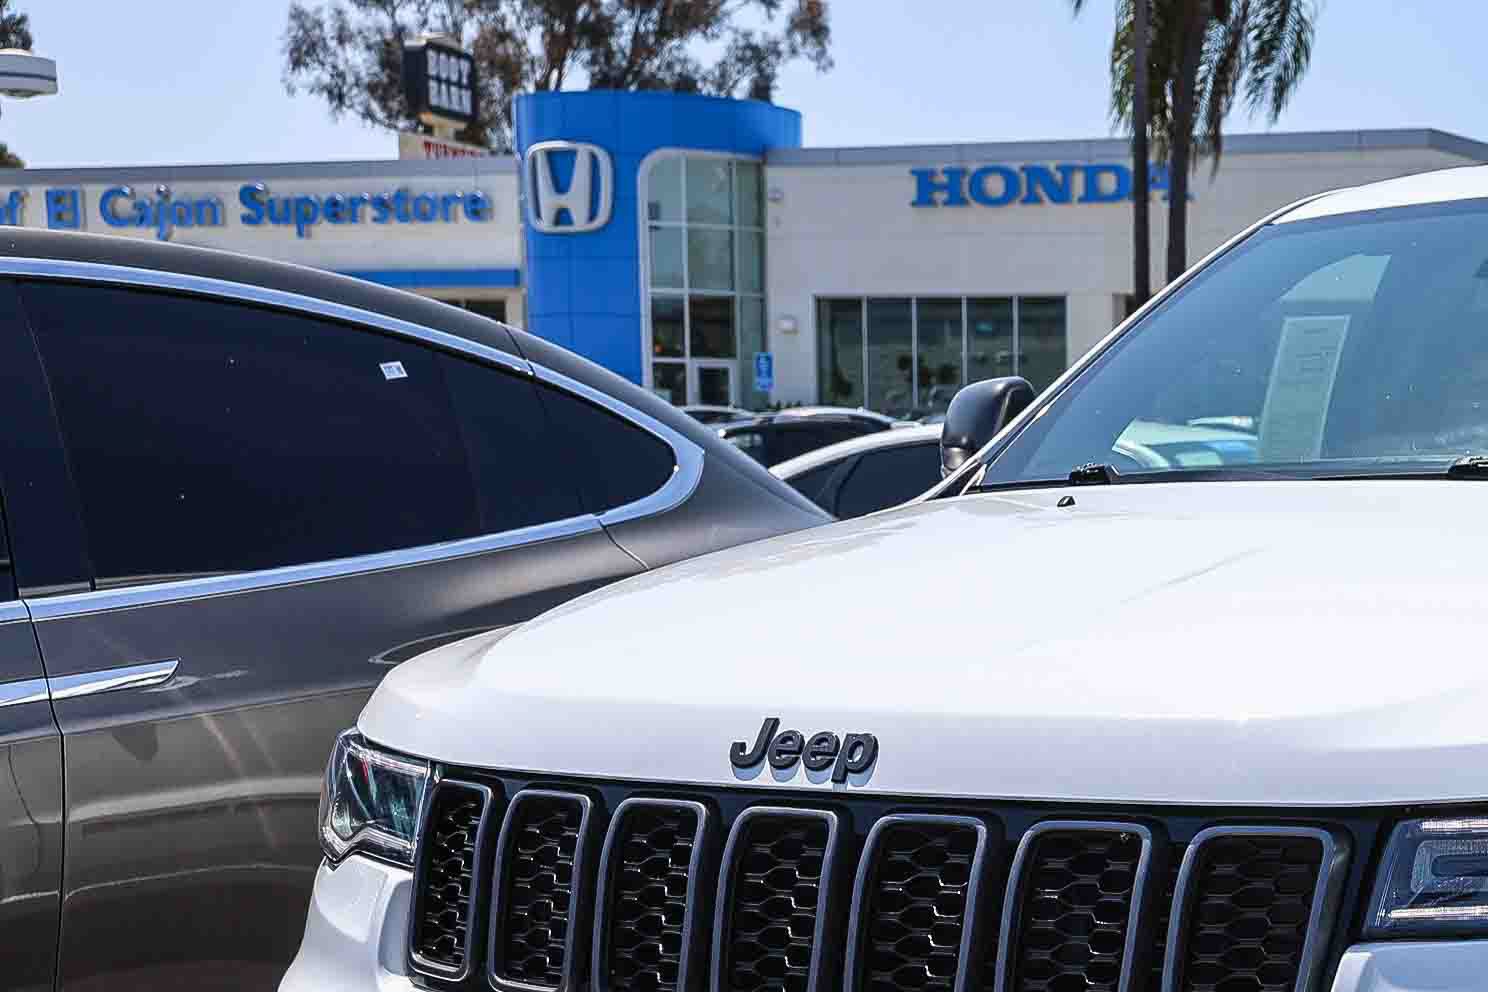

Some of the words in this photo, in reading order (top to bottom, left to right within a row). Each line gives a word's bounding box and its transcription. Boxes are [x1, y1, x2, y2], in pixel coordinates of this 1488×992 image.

[46, 188, 81, 229] El
[100, 185, 224, 241] Cajon
[239, 184, 494, 239] Superstore
[729, 717, 880, 784] Jeep
